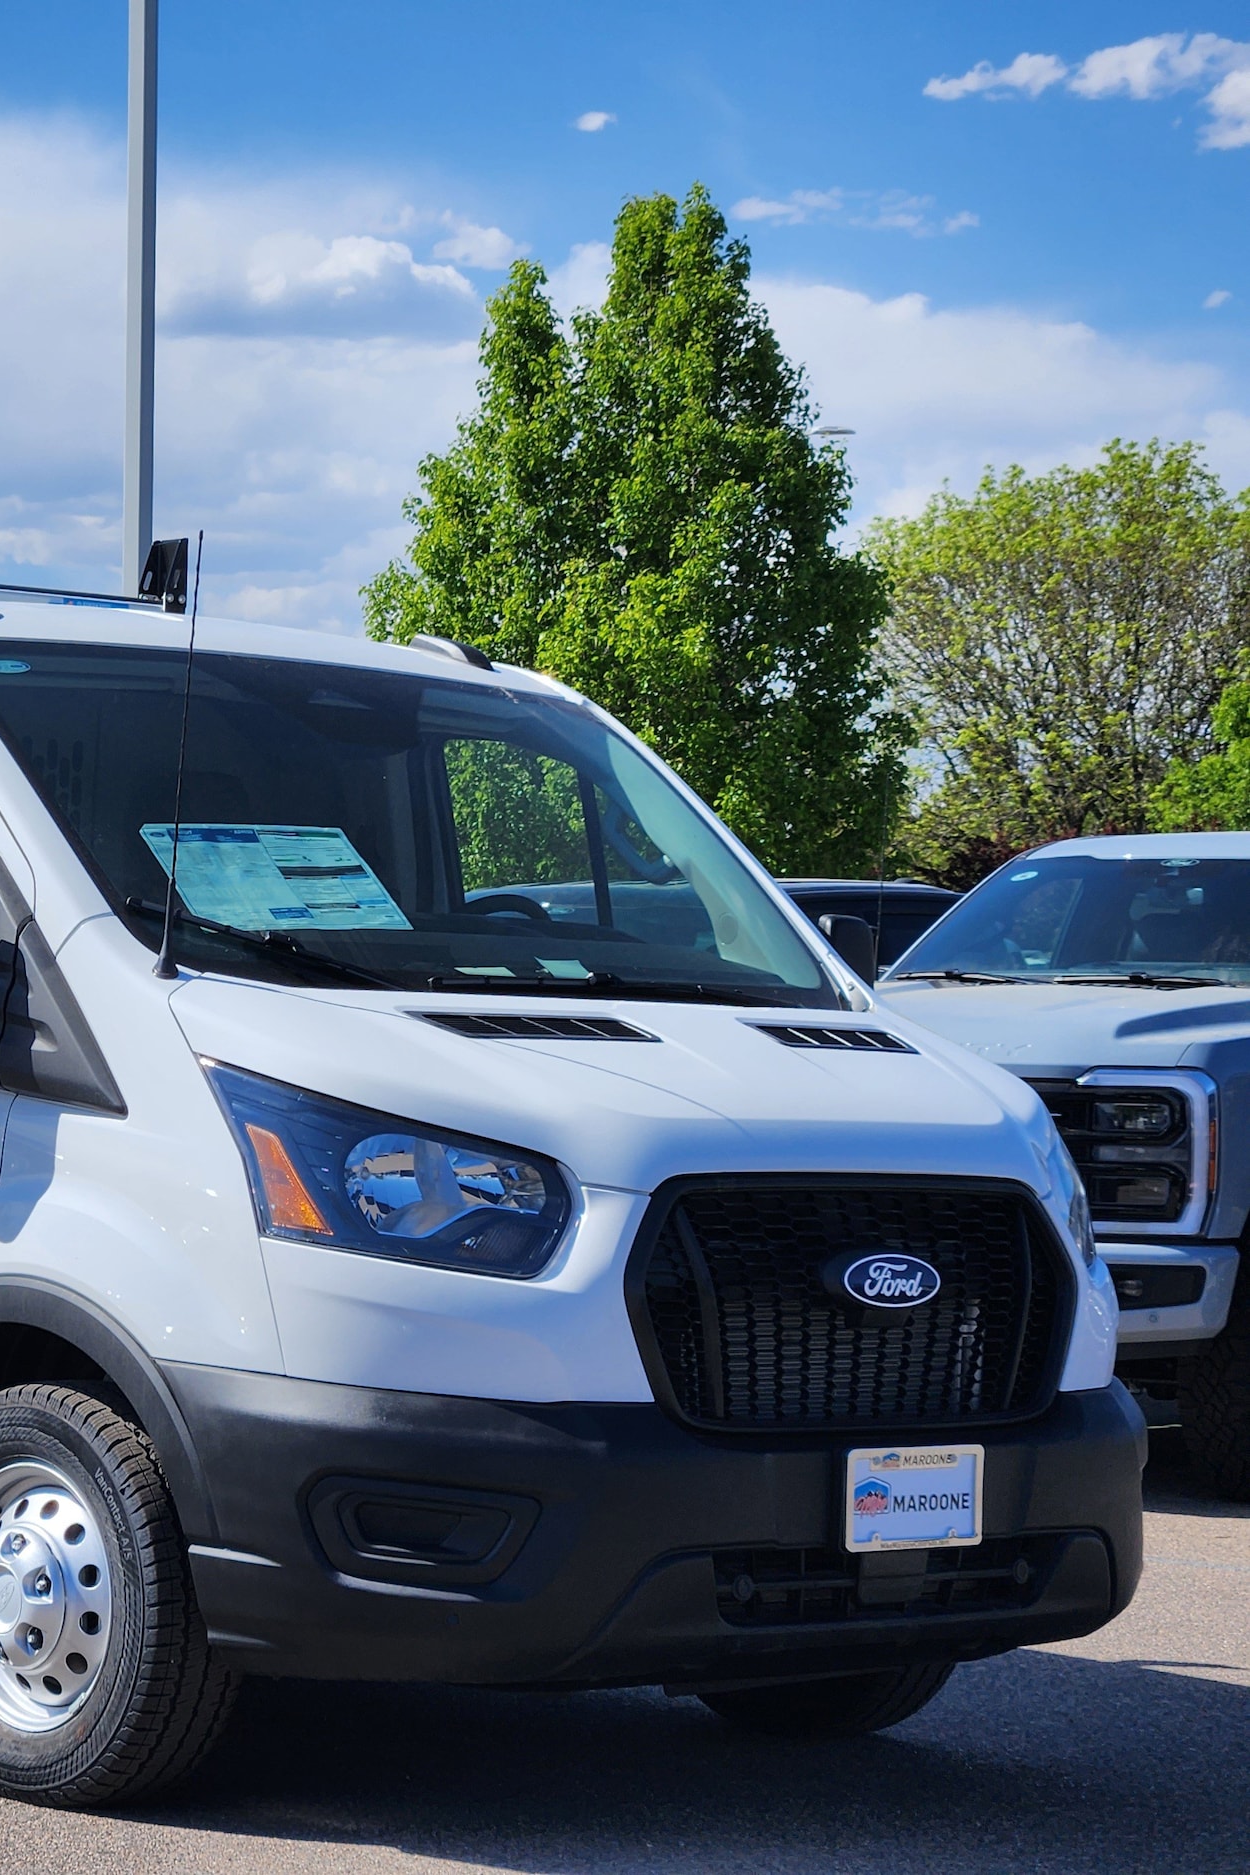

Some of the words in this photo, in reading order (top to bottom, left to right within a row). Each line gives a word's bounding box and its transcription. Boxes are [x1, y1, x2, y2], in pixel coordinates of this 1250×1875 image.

[864, 1261, 923, 1297] Ford
[902, 1453, 955, 1466] MAROONE
[94, 1467, 127, 1533] VanContact
[121, 1536, 133, 1561] A/S
[892, 1492, 970, 1513] MAROONE
